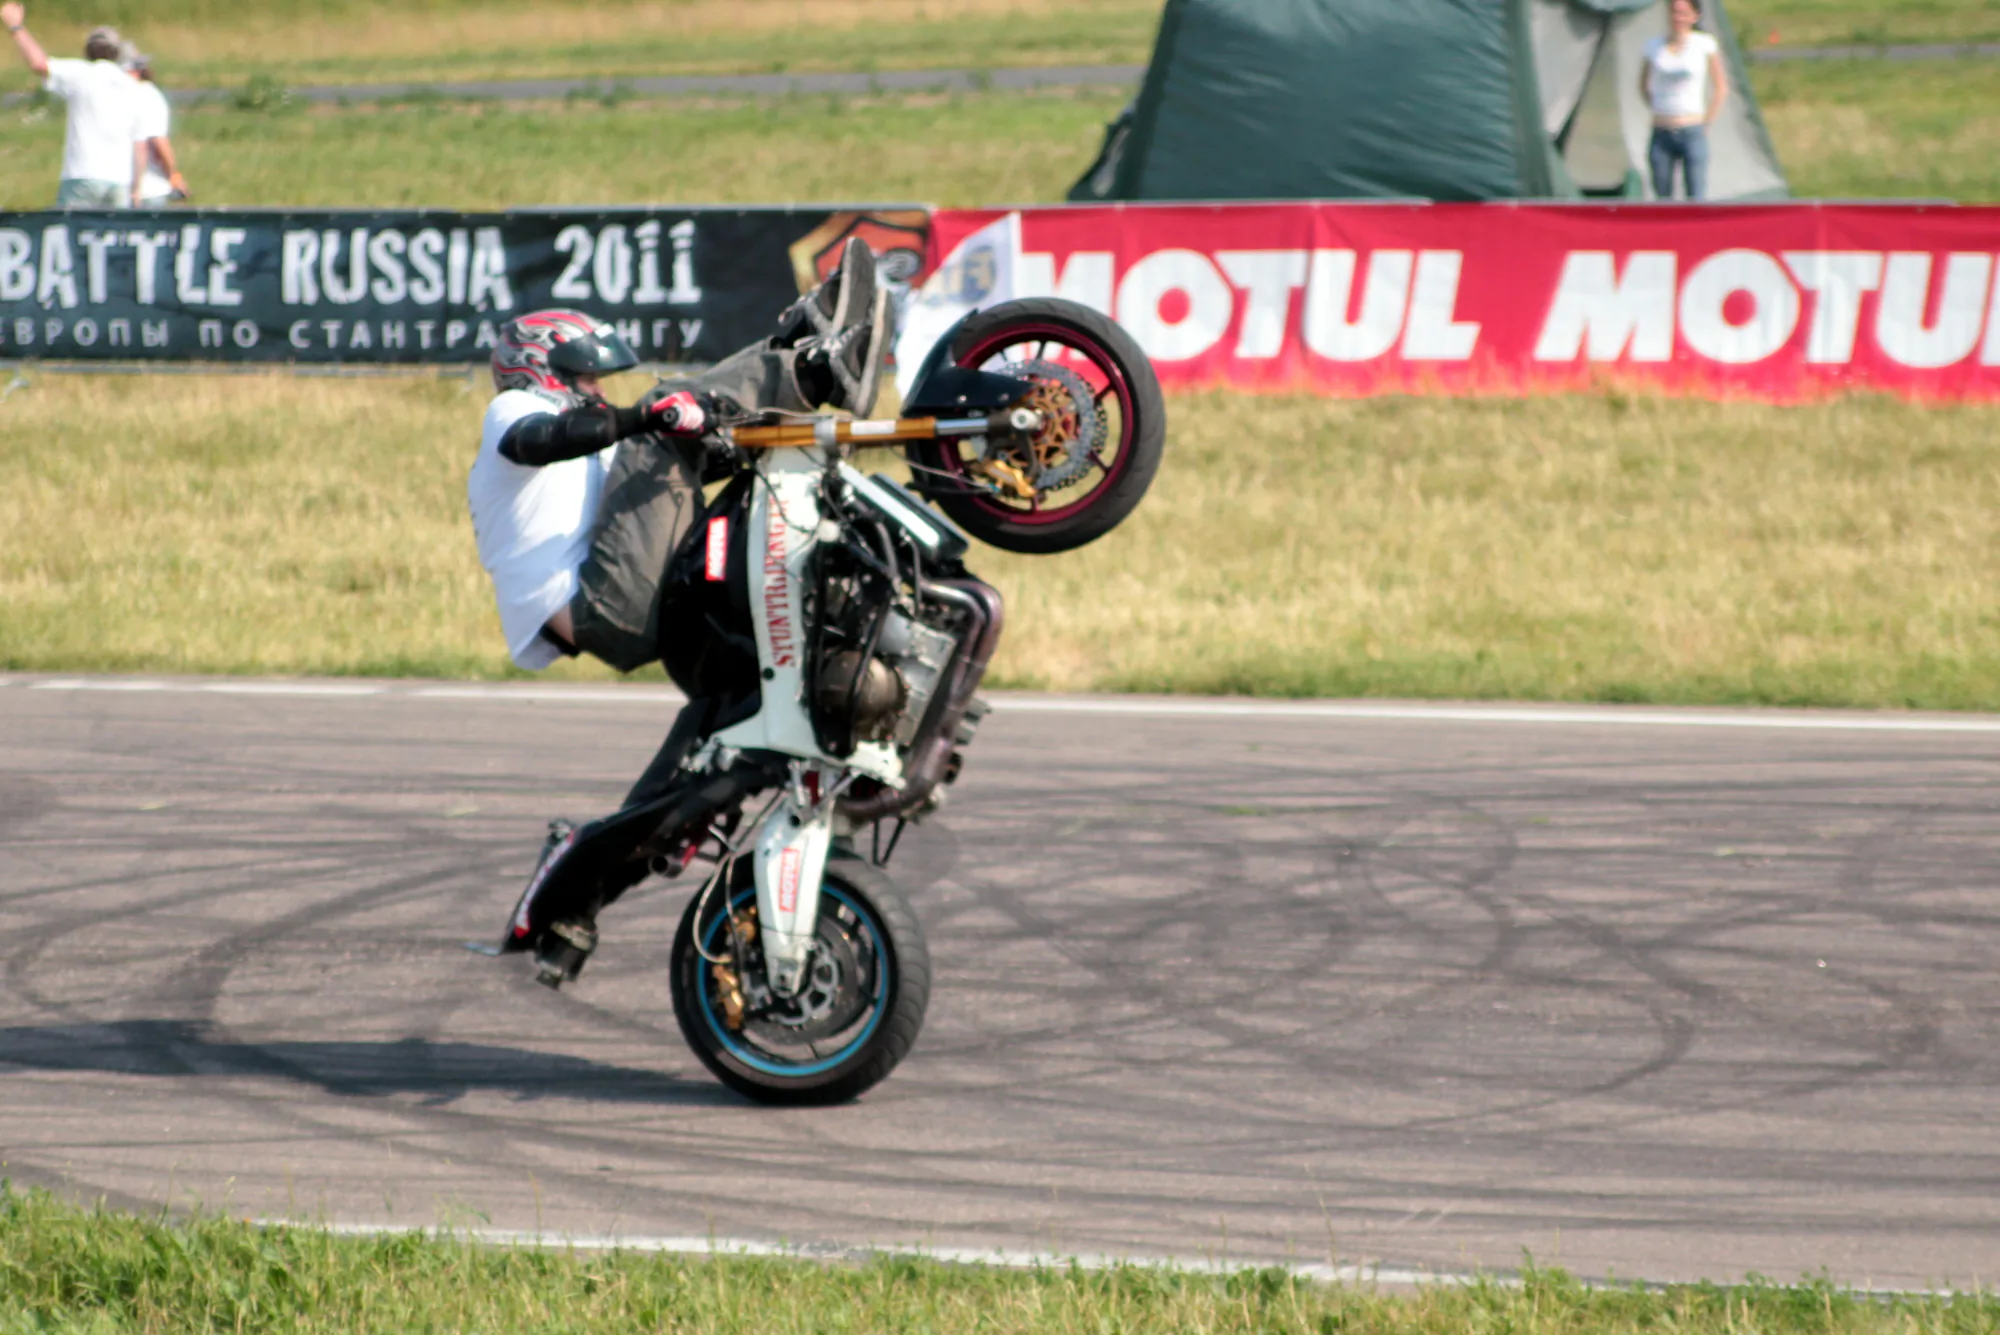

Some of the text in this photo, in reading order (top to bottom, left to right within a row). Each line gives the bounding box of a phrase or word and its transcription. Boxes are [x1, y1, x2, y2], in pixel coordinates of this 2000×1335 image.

[0, 220, 702, 311] BATTLE RUSSIA 2011
[0, 317, 169, 347] ВРОПЫ
[199, 320, 260, 348] ПО
